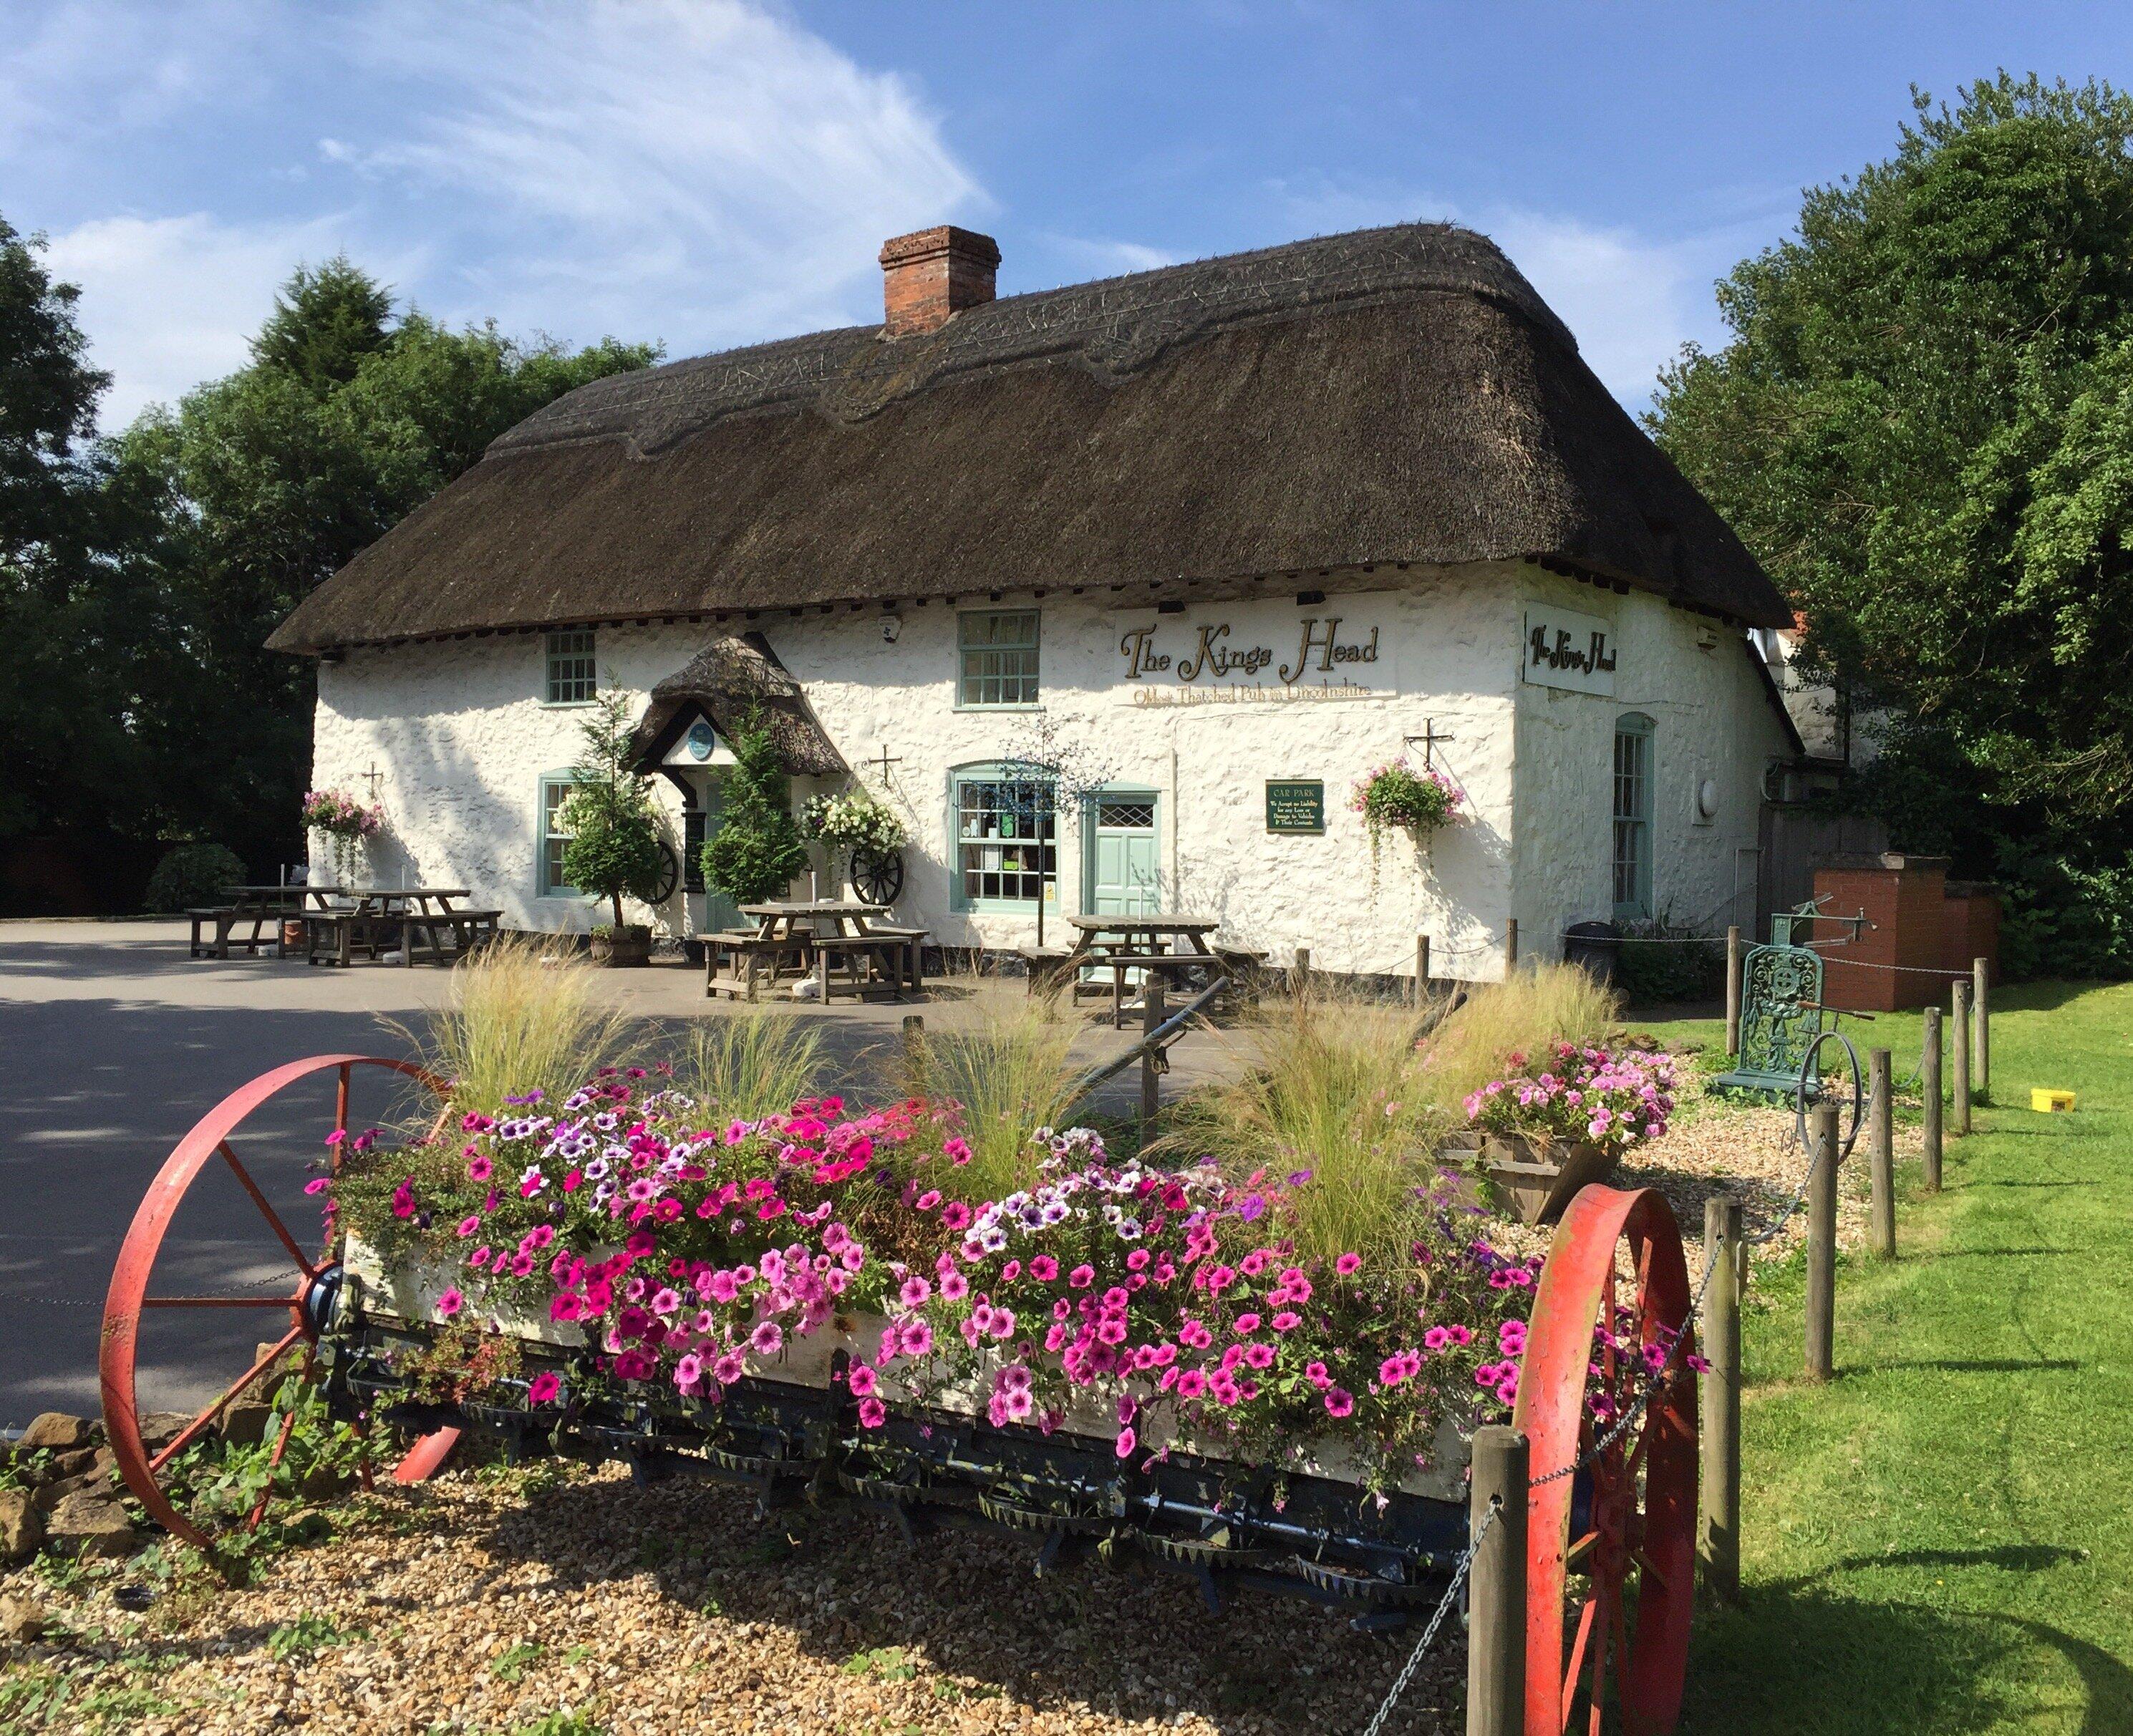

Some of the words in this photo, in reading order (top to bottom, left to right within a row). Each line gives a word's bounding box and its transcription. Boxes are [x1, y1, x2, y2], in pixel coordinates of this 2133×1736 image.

[1121, 624, 1171, 679] The
[1178, 624, 1272, 682] Kings
[1279, 618, 1378, 682] Head
[1177, 683, 1234, 704] Thatched
[1239, 682, 1265, 702] Pub
[1270, 687, 1282, 700] in
[1284, 677, 1372, 699] Lincolnshire
